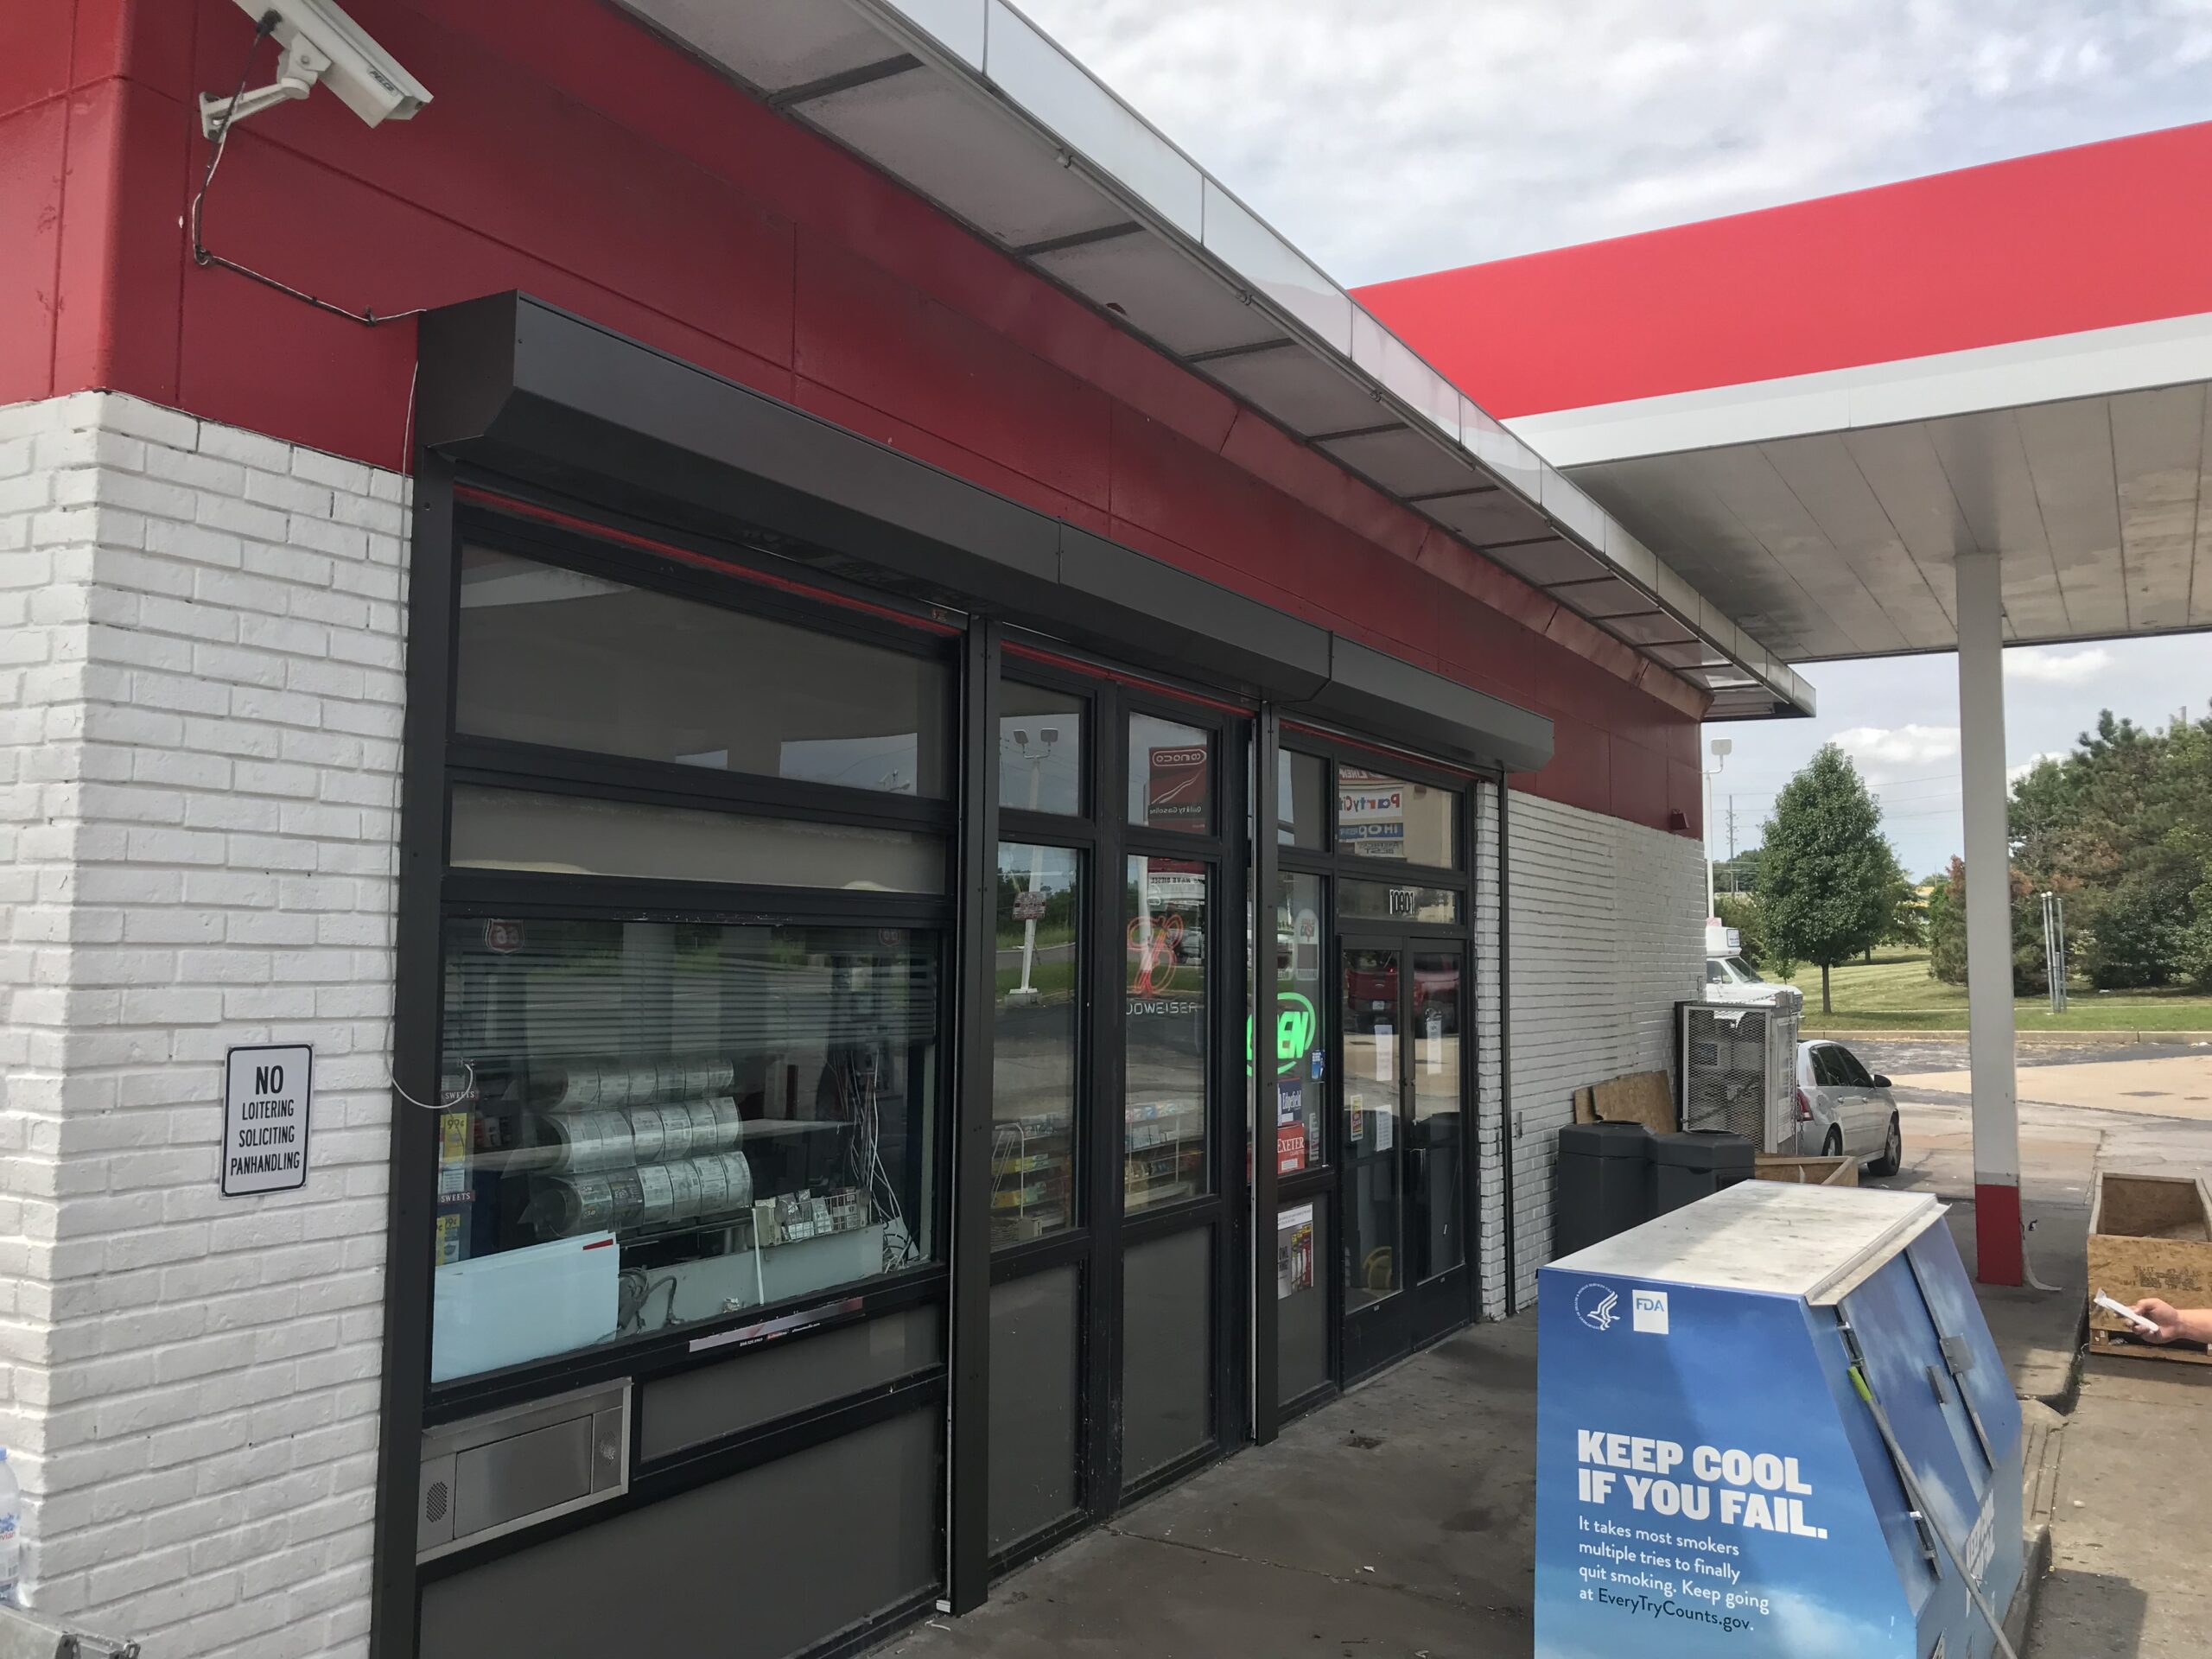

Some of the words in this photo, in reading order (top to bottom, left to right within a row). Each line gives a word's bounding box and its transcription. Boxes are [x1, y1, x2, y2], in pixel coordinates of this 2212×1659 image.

[256, 1065, 284, 1095] NO
[445, 1090, 475, 1100] SWEETS
[242, 1098, 295, 1121] LOITERING
[238, 1125, 295, 1147] SOLICITING
[1277, 1136, 1305, 1154] EXETER
[230, 1151, 300, 1176] PANHANDLING
[441, 1192, 471, 1203] SWEETS
[1636, 1298, 1664, 1312] FDA
[1578, 1429, 1684, 1474] KEEP
[1692, 1445, 1812, 1496] COOL
[1579, 1468, 1617, 1504] IF
[1623, 1474, 1710, 1521] YOU
[1719, 1489, 1828, 1540] FAIL.
[1580, 1516, 1590, 1531] It
[1593, 1520, 1631, 1538] takes
[1636, 1529, 1673, 1545] most
[1676, 1536, 1739, 1556] smokers
[1579, 1541, 1637, 1565] multiple
[1640, 1551, 1671, 1568] tries
[1675, 1556, 1690, 1572] to
[1694, 1558, 1740, 1586] finally
[1579, 1565, 1606, 1582] quit
[1610, 1573, 1677, 1598] smoking.
[1681, 1580, 1721, 1605] Keep
[1726, 1591, 1770, 1615] going
[1579, 1587, 1593, 1601] at
[1598, 1587, 1754, 1632] EveryTryCounts.gov.
